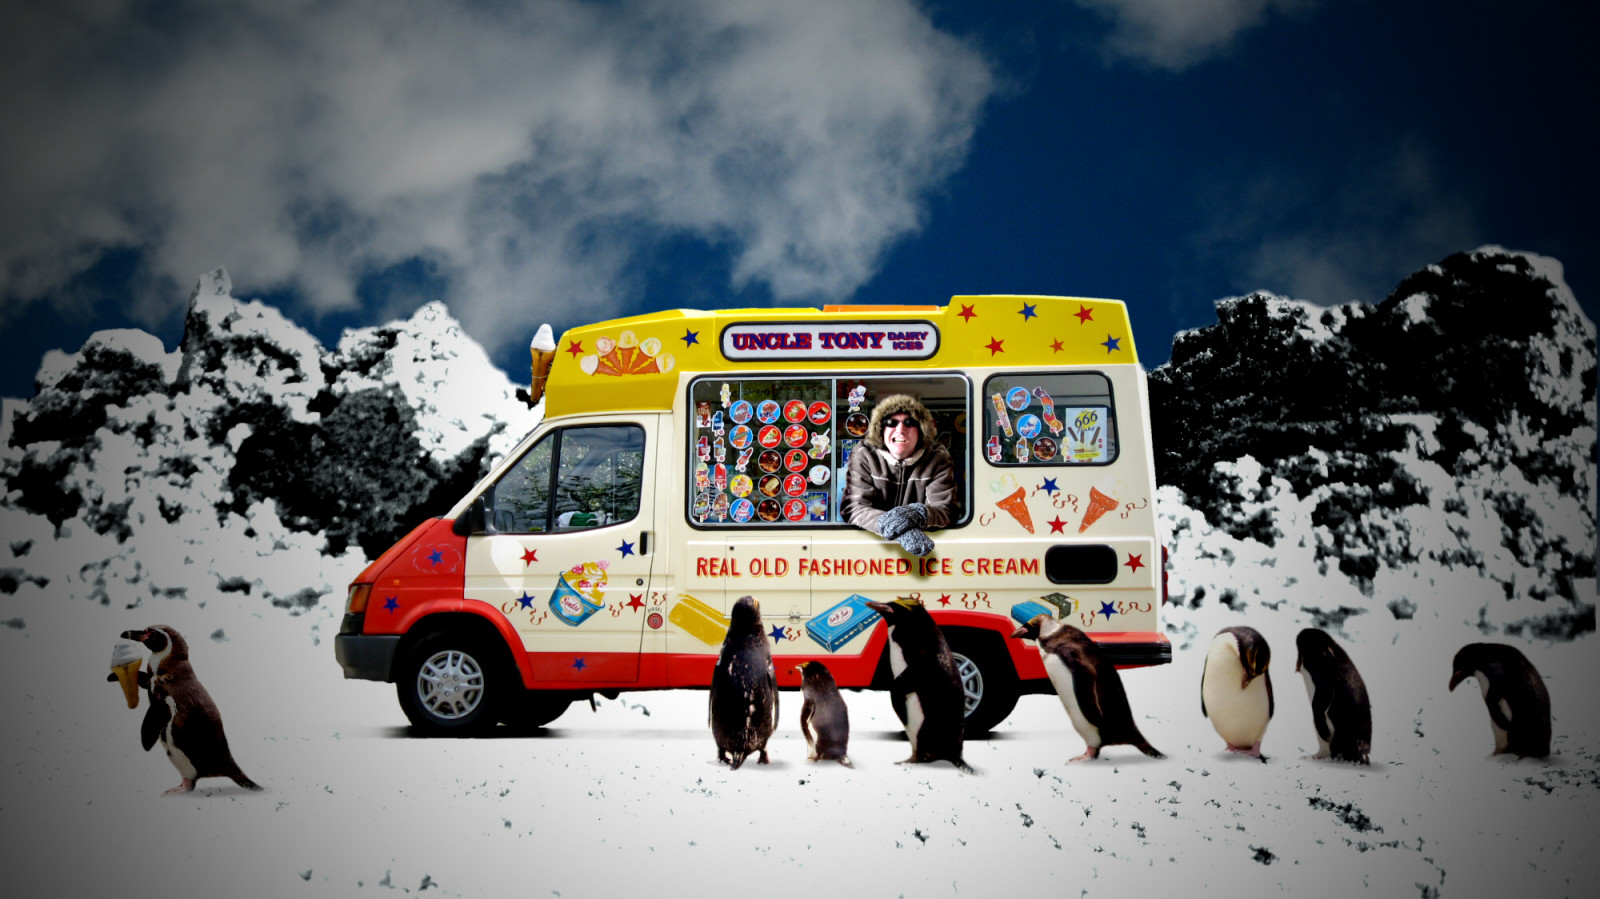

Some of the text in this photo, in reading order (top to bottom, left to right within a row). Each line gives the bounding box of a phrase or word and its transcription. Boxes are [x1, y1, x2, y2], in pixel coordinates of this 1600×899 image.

[731, 332, 885, 350] UNCLE TONY
[887, 331, 929, 341] DAIRY
[892, 341, 924, 350] ICES
[1074, 410, 1098, 428] 666
[696, 557, 1041, 577] REAL OLD FASHIONED ICE CREAM
